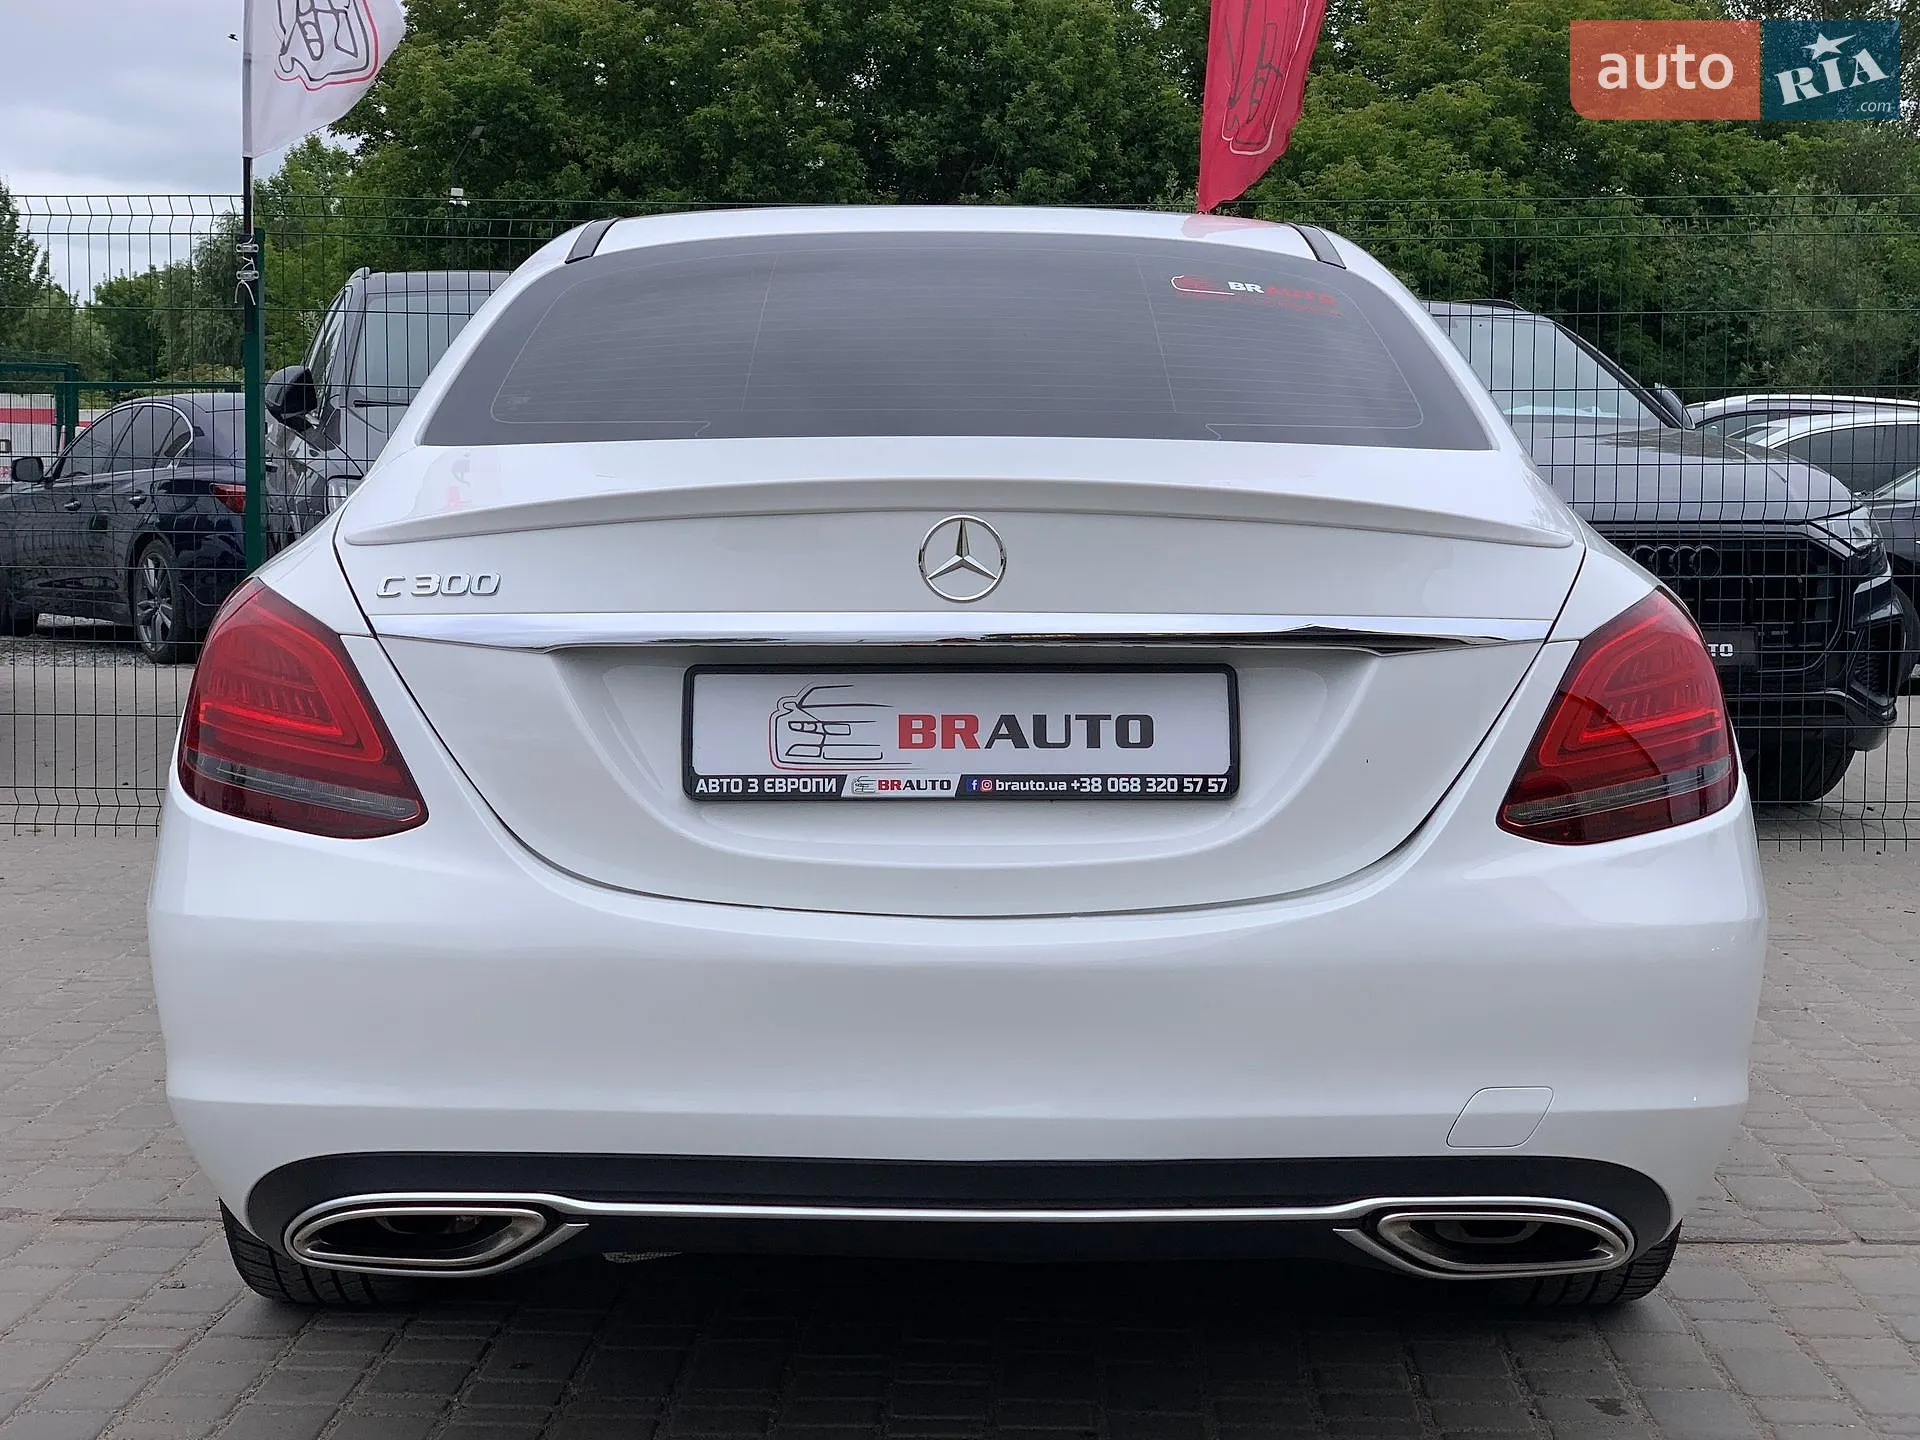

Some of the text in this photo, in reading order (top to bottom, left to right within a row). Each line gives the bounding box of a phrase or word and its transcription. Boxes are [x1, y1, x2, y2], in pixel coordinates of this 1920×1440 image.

[376, 573, 501, 598] C 300
[897, 713, 1155, 750] BRAUTO
[695, 778, 742, 793] АВТО
[763, 778, 837, 793] ЄВРОПИ
[877, 779, 952, 791] BRAUTO
[995, 777, 1228, 793] brauto.ua +38 068 320 57 57
